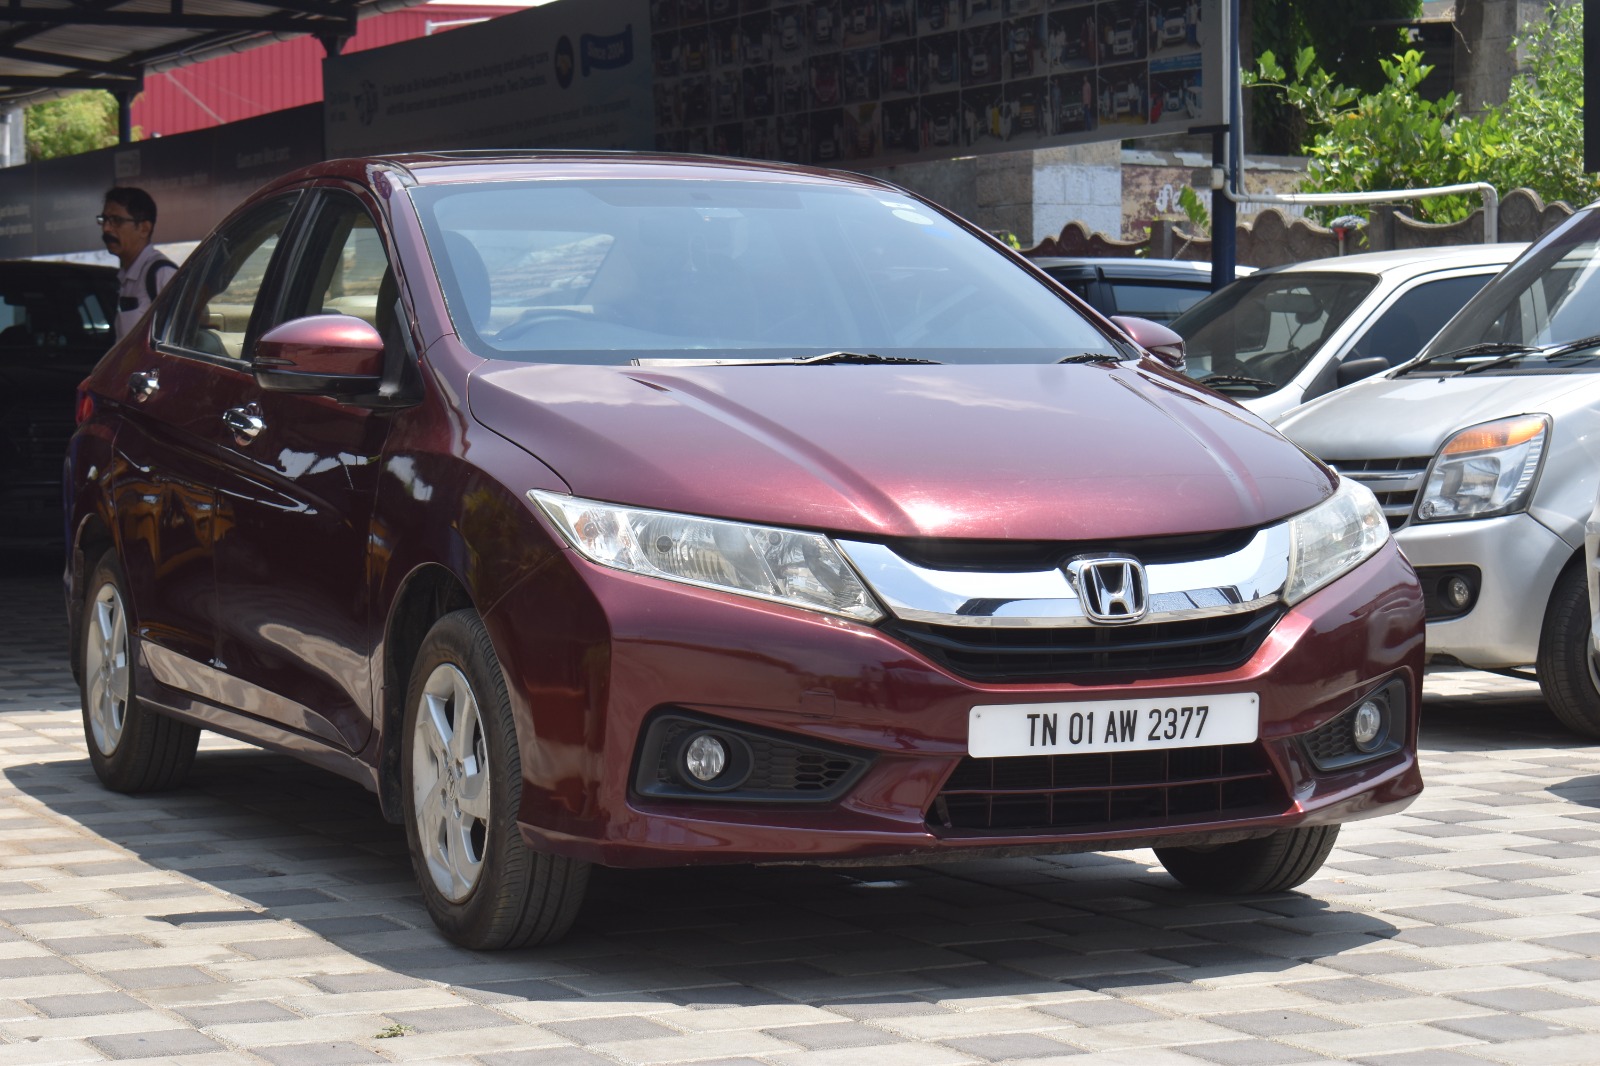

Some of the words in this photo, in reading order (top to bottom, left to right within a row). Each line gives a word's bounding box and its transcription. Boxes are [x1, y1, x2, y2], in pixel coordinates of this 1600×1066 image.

[1026, 713, 1058, 747] TN
[1068, 711, 1094, 745] 01
[1103, 709, 1138, 744] AW
[1147, 705, 1209, 742] 2377
